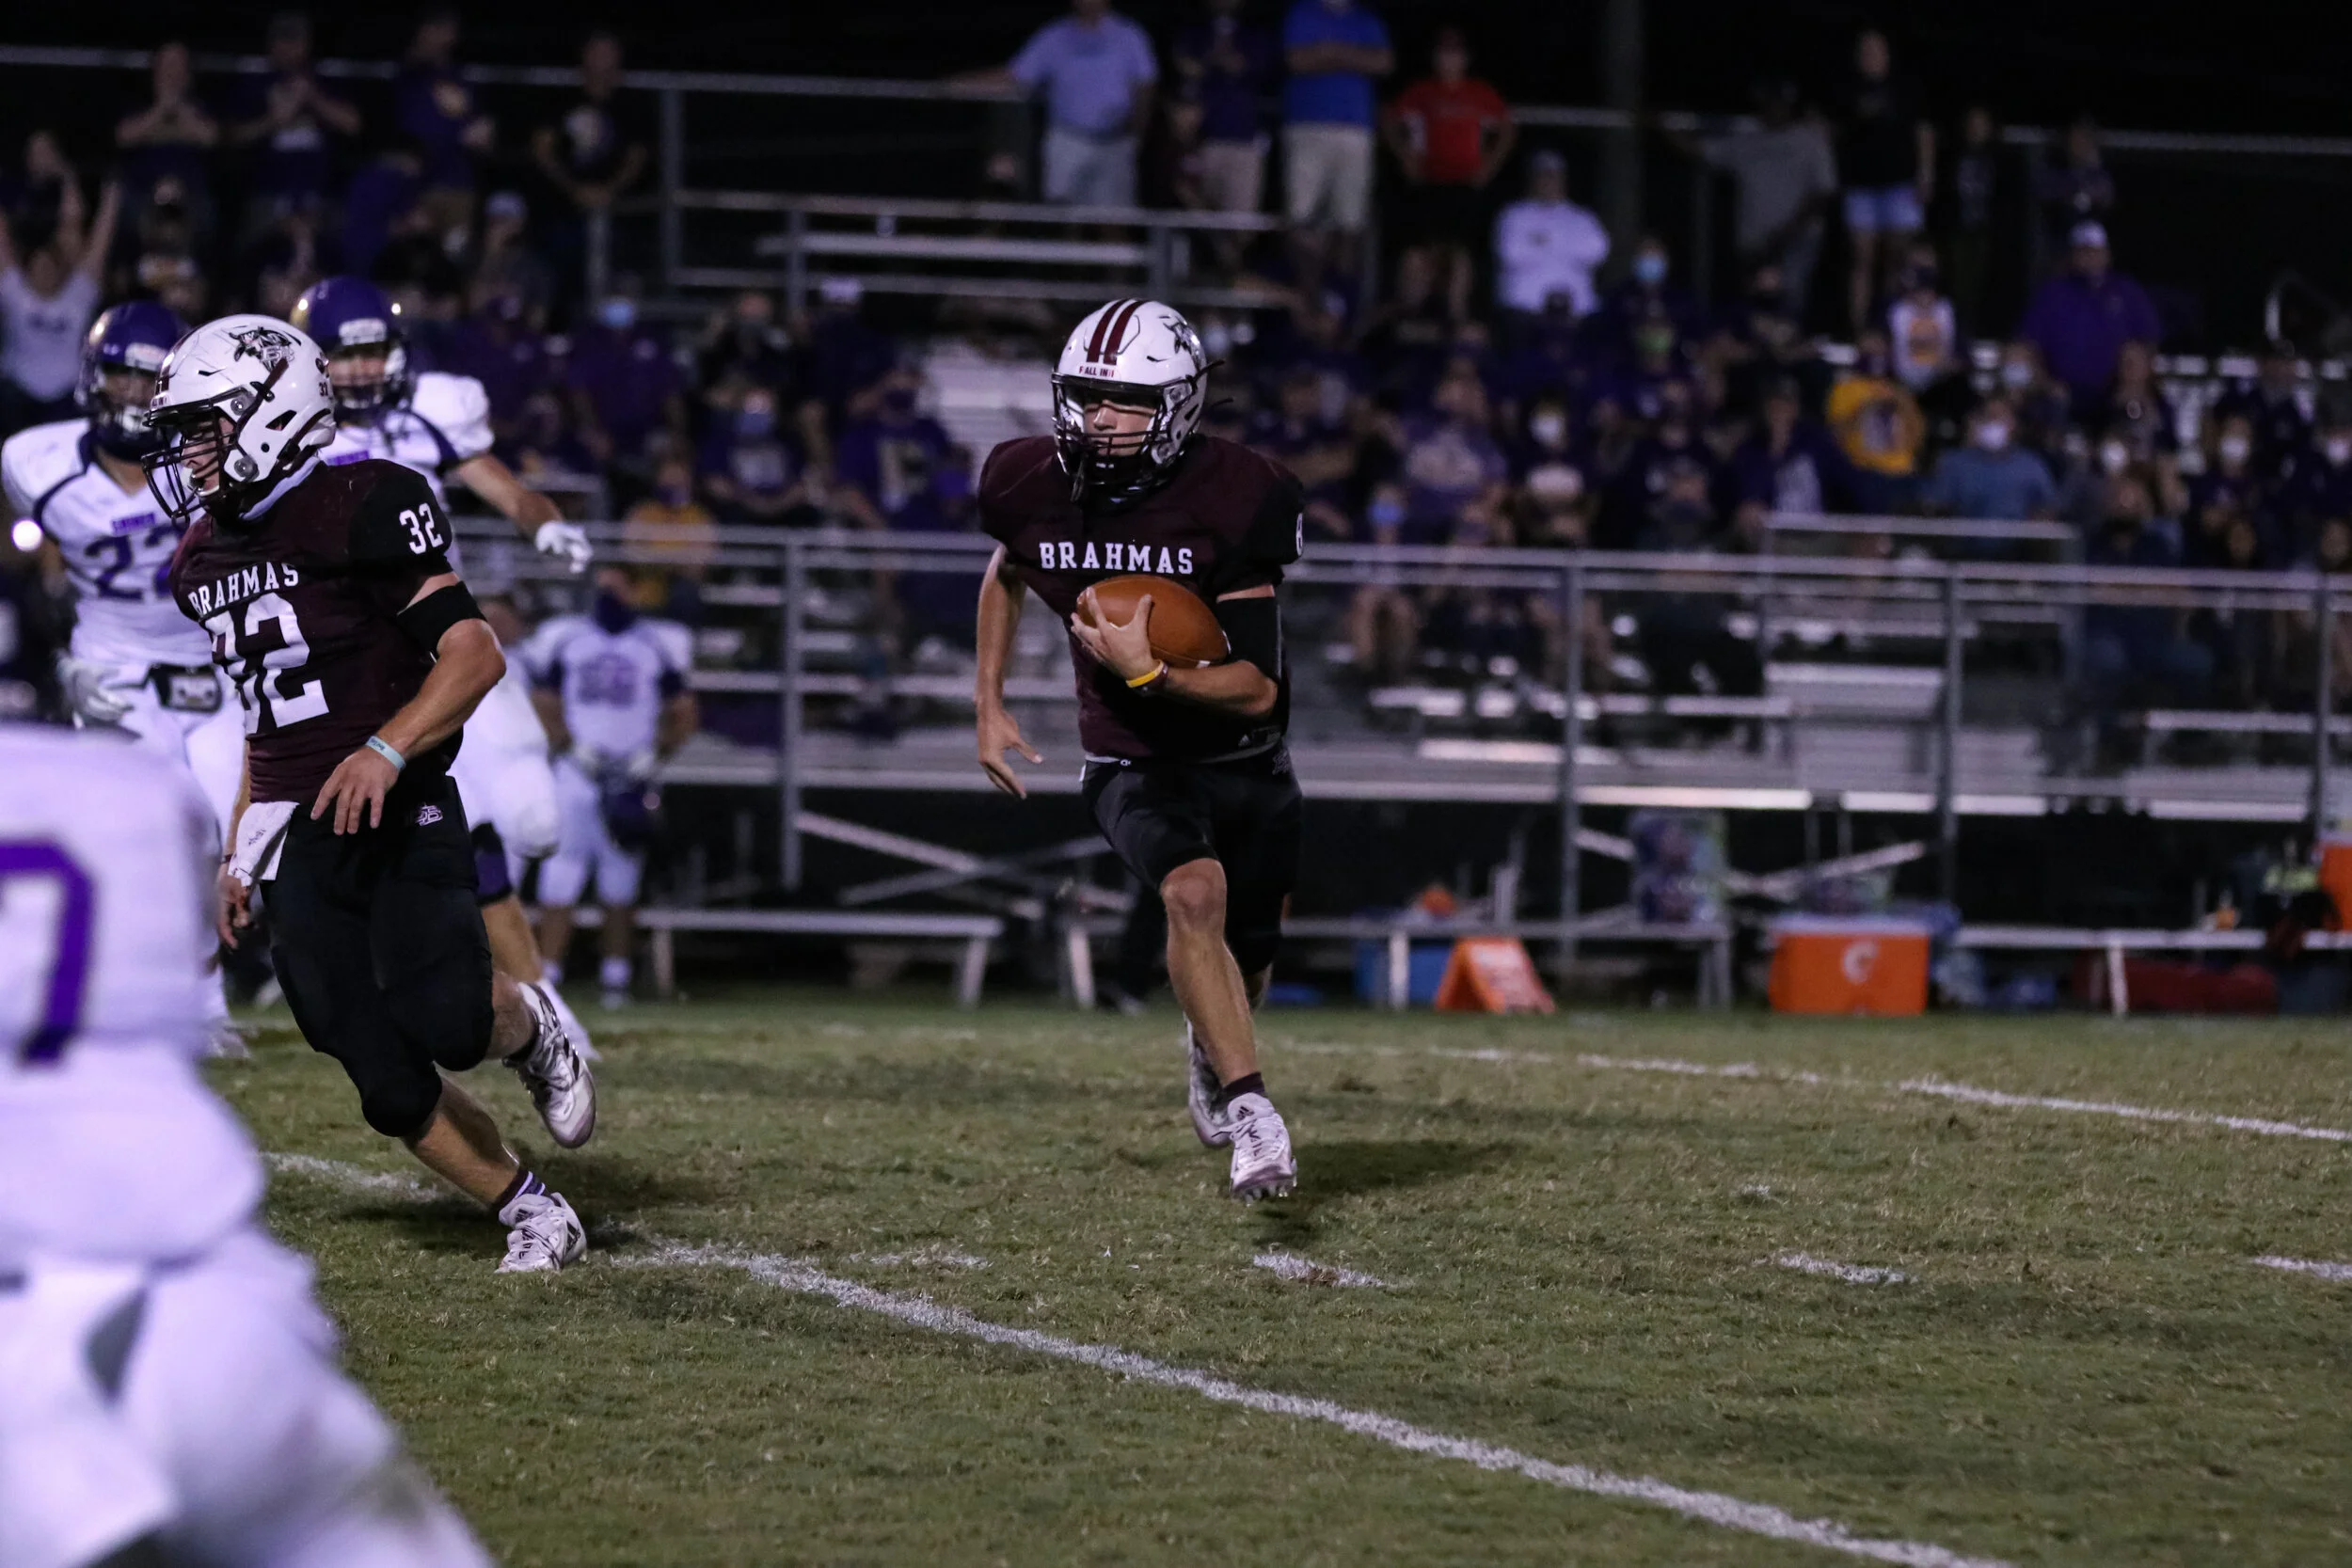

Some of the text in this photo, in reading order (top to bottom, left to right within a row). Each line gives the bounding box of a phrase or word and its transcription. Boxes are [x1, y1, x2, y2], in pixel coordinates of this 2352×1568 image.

[399, 503, 444, 555] 32
[1039, 542, 1193, 575] BRAHMAS
[188, 562, 299, 617] BRAHMAS
